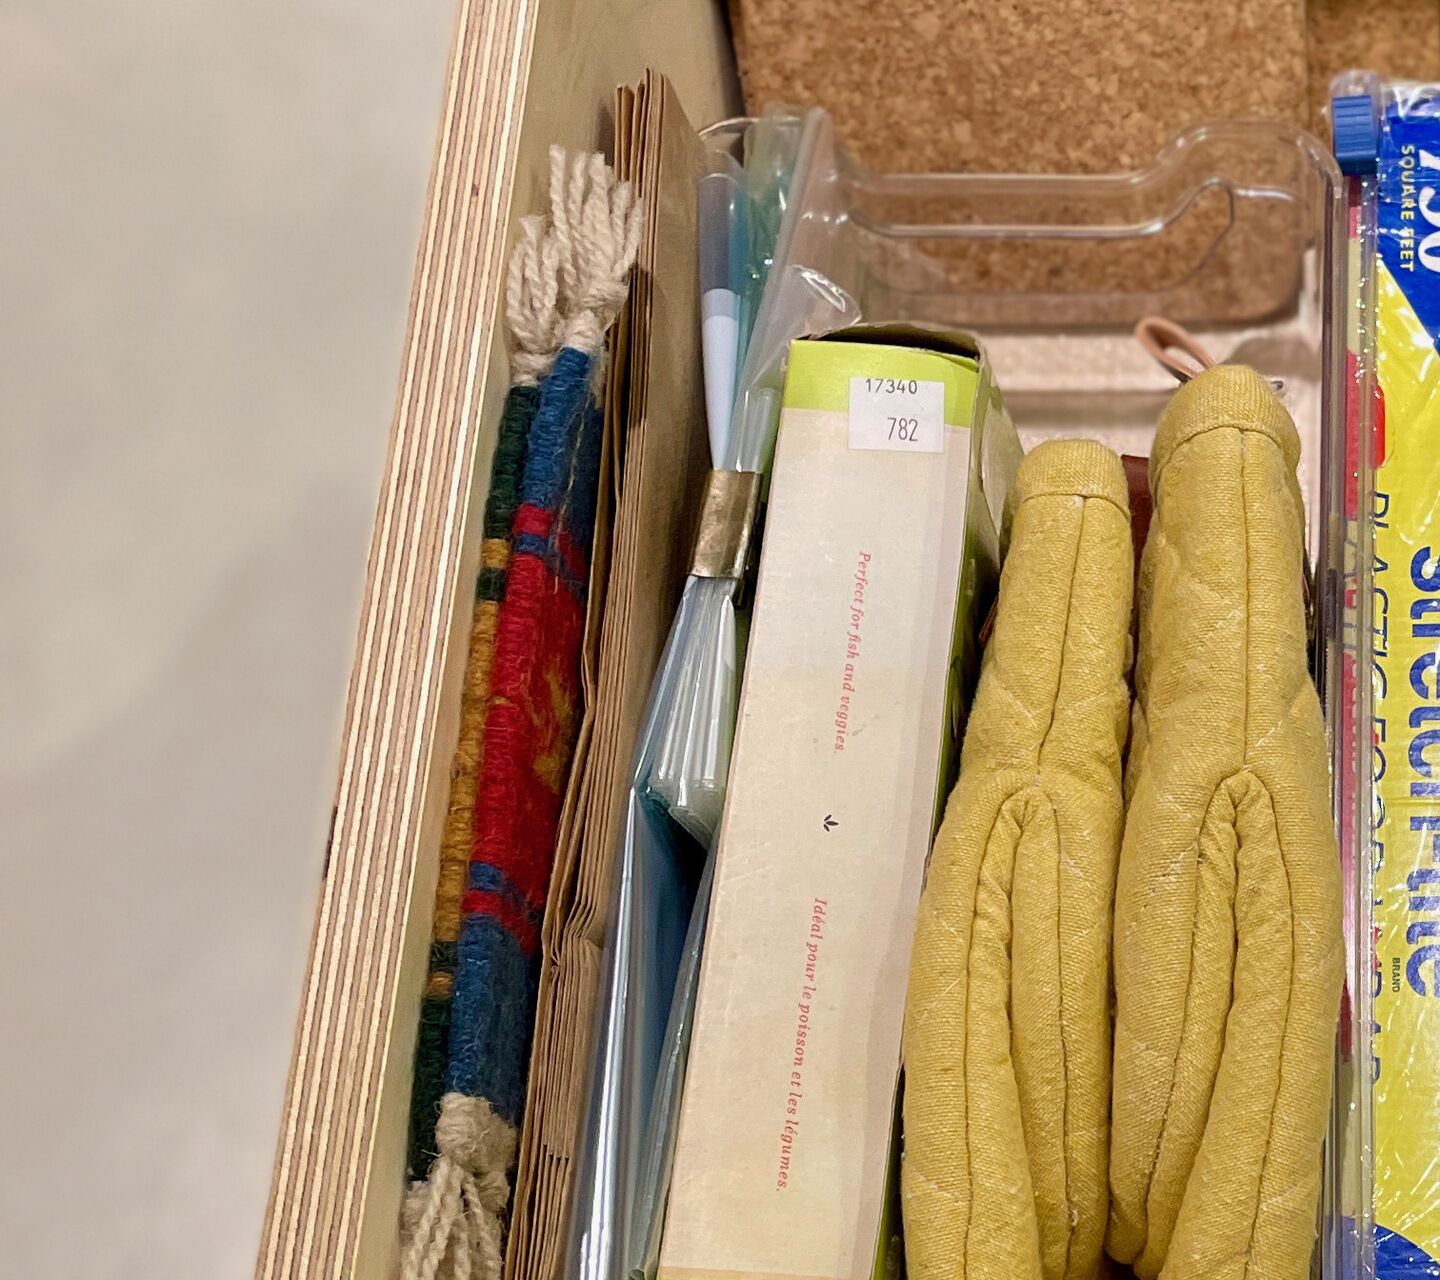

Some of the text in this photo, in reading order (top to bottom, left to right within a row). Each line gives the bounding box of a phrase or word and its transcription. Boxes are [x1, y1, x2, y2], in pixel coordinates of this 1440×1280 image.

[1398, 145, 1416, 272] SQUARE FEET
[865, 378, 918, 395] 17340
[887, 417, 918, 442] 782
[834, 551, 871, 754] Perfect for fish and veggies.
[1391, 956, 1401, 994] BRAND
[776, 897, 828, 1192] Idéal pour le poisson et les légumes.
